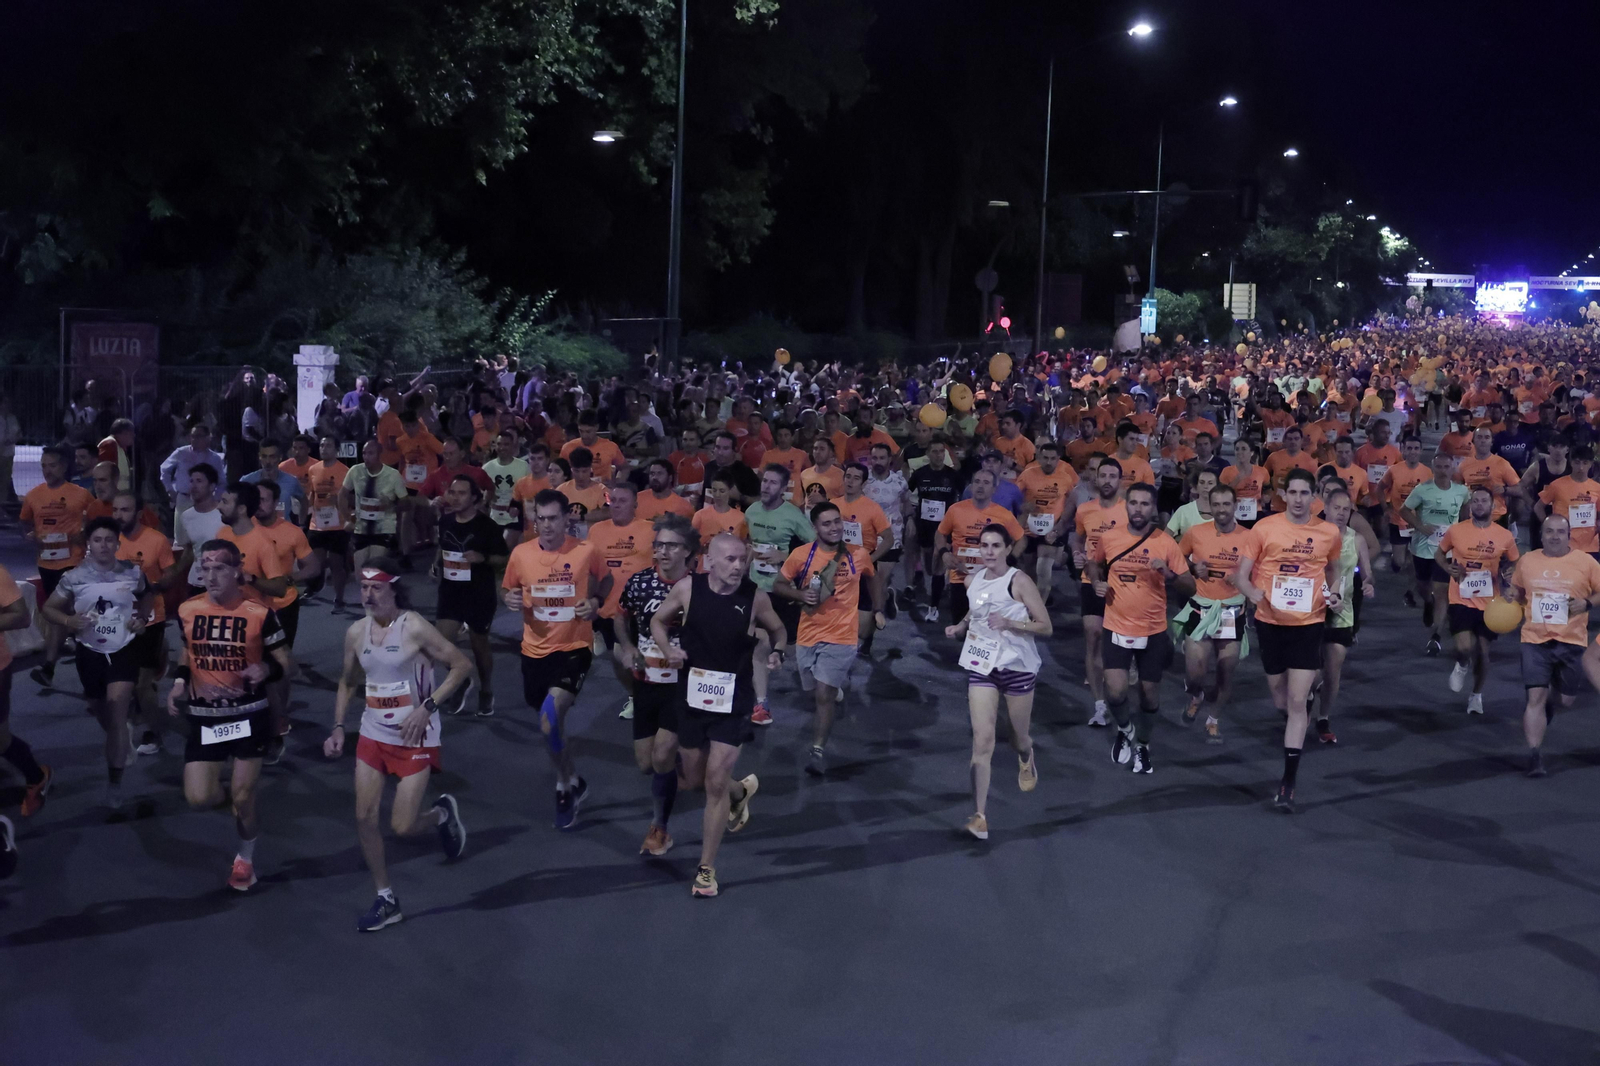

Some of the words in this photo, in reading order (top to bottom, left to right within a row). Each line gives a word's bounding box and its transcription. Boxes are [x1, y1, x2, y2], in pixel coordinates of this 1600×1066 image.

[90, 337, 141, 357] LUZIA
[1466, 580, 1487, 588] 16079
[1283, 588, 1303, 597] 2533
[544, 598, 565, 607] 1009
[1541, 603, 1559, 611] 7029
[93, 624, 117, 635] 14094
[191, 615, 247, 643] BEER
[192, 643, 246, 658] RUNNERS
[968, 645, 990, 661] 20802
[194, 658, 248, 672] TALAVERA
[697, 682, 725, 696] 20800
[377, 698, 400, 708] 1405
[213, 723, 242, 738] 19975
